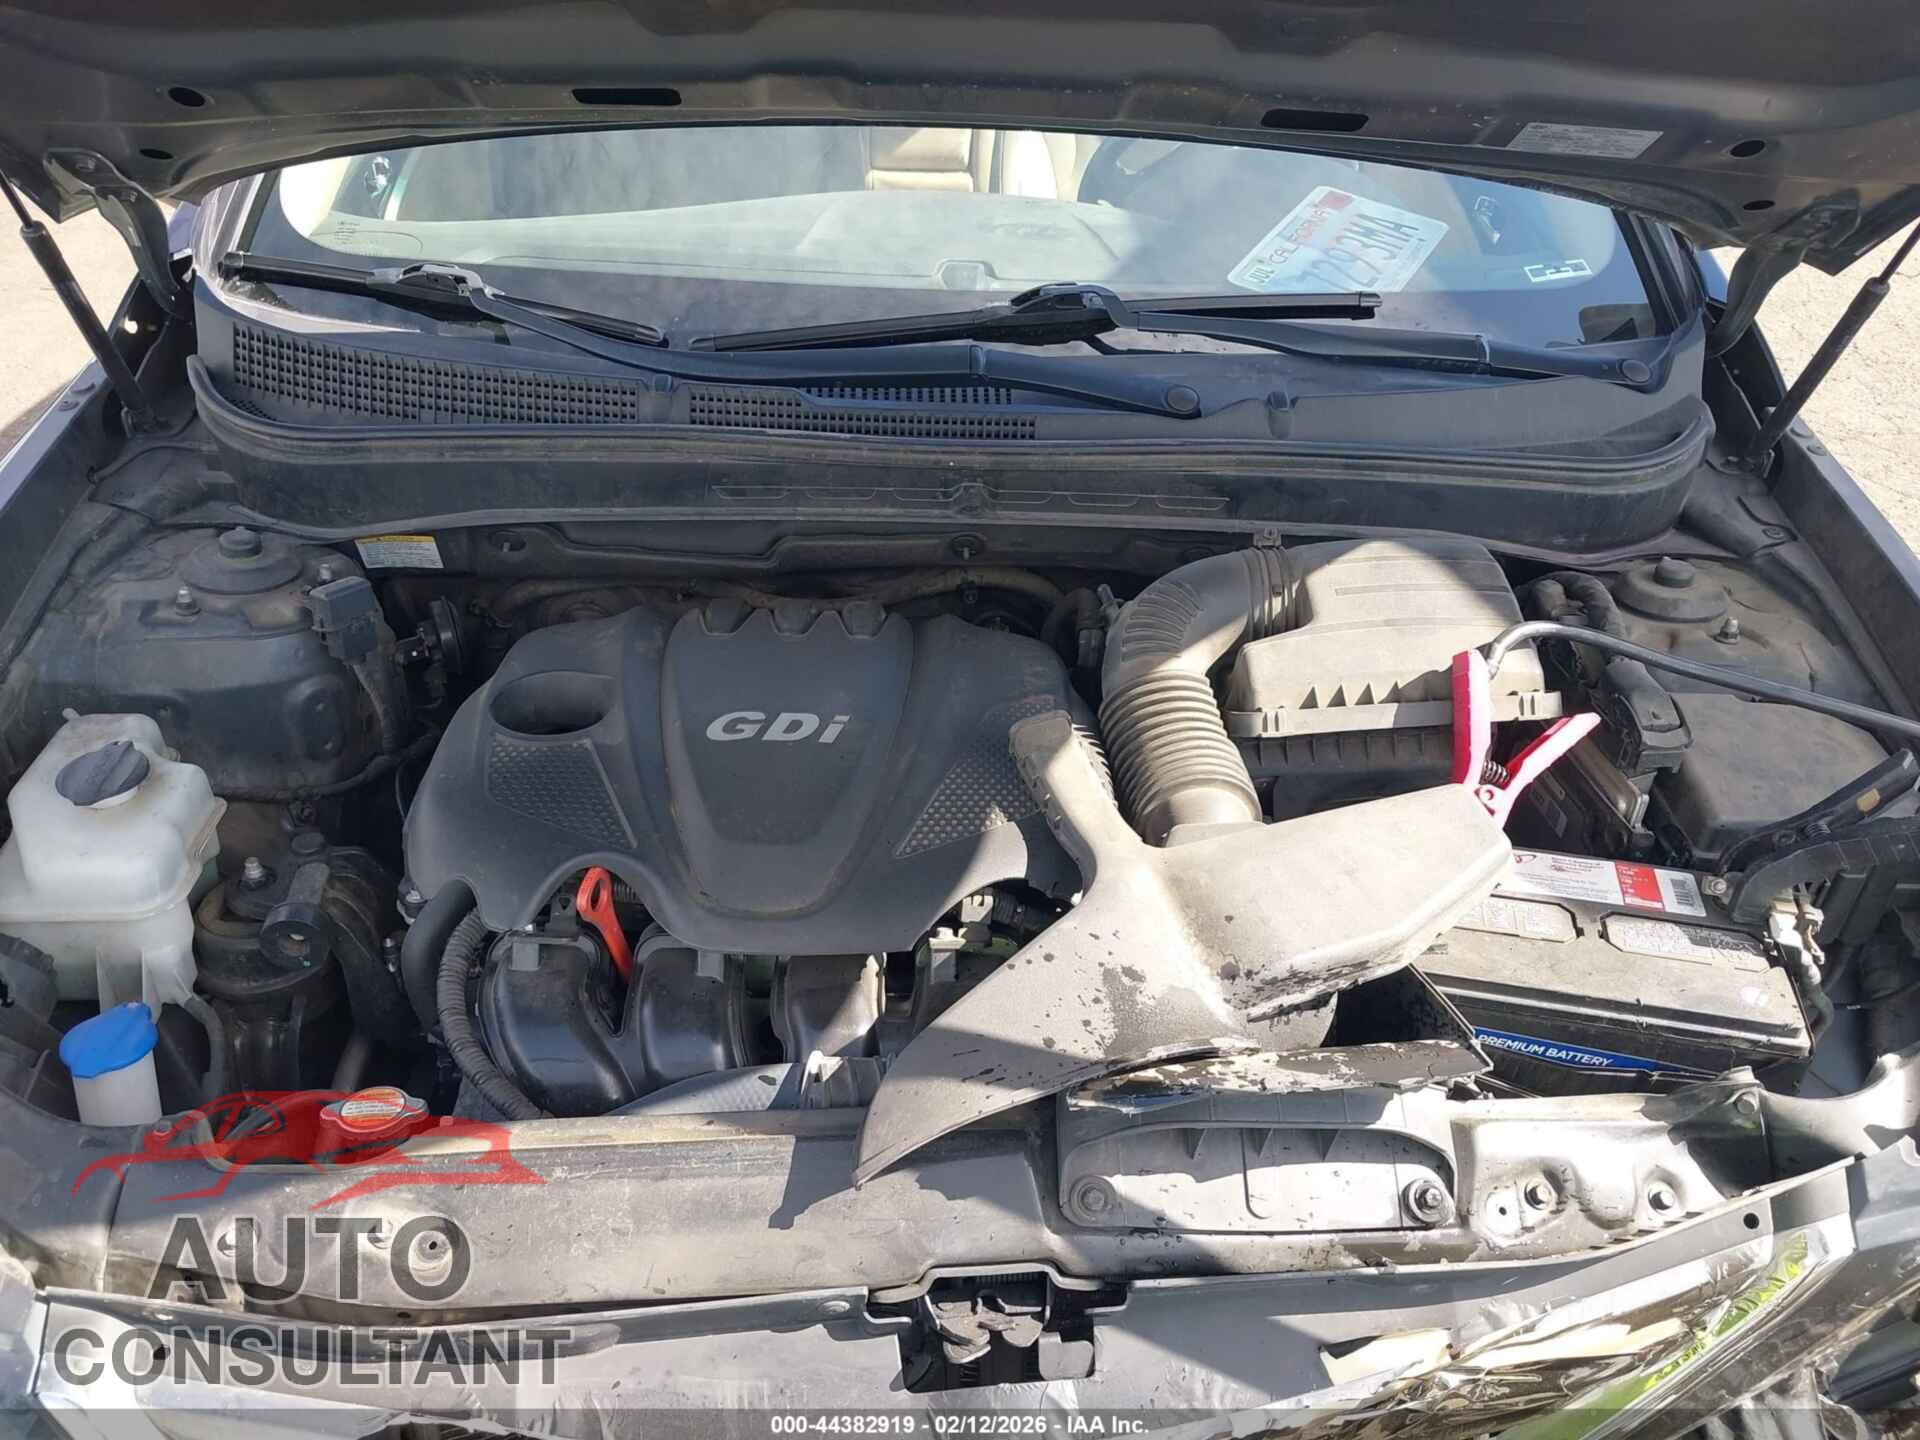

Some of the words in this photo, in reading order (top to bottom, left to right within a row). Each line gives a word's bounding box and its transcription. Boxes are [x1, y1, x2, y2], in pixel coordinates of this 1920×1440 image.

[705, 710, 851, 744] GDi
[1477, 1033, 1545, 1056] PREMIUM
[1546, 1046, 1614, 1067] BATTERY
